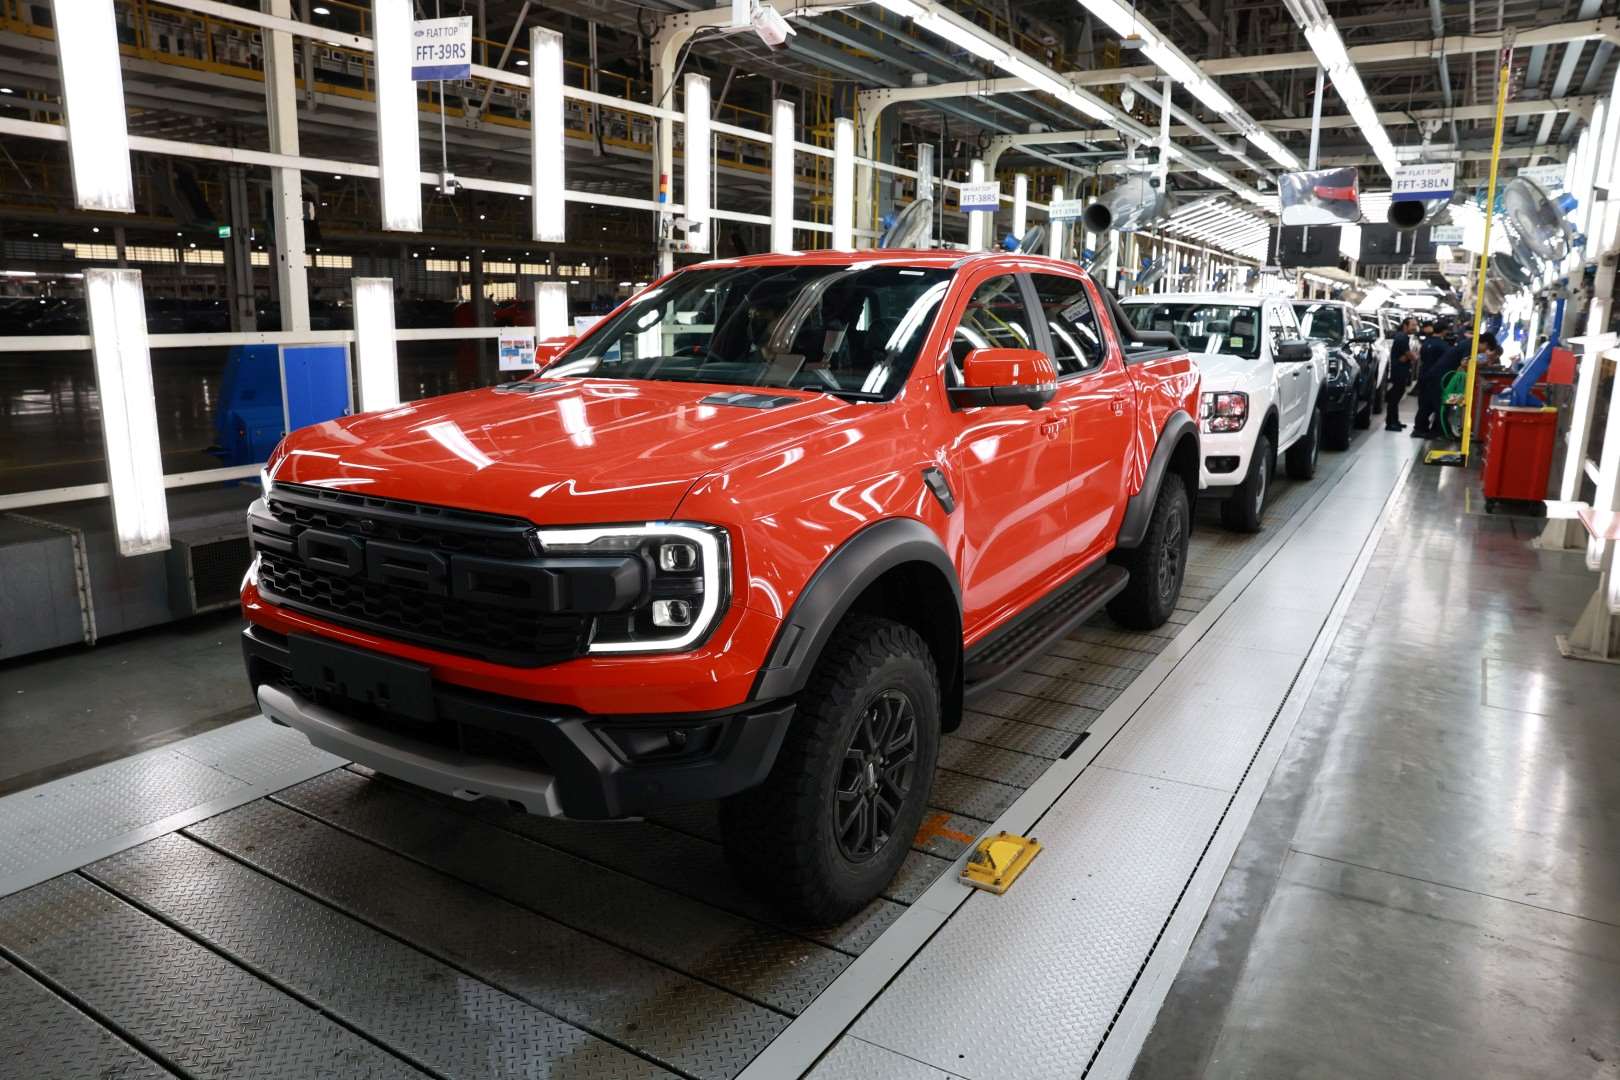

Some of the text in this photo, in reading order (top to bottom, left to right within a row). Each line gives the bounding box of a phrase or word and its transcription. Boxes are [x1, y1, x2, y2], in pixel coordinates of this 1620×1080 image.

[427, 27, 443, 37] FLAT
[444, 26, 458, 36] TOP
[416, 43, 466, 61] FFT-39RS
[1397, 178, 1449, 190] FFT-38LN
